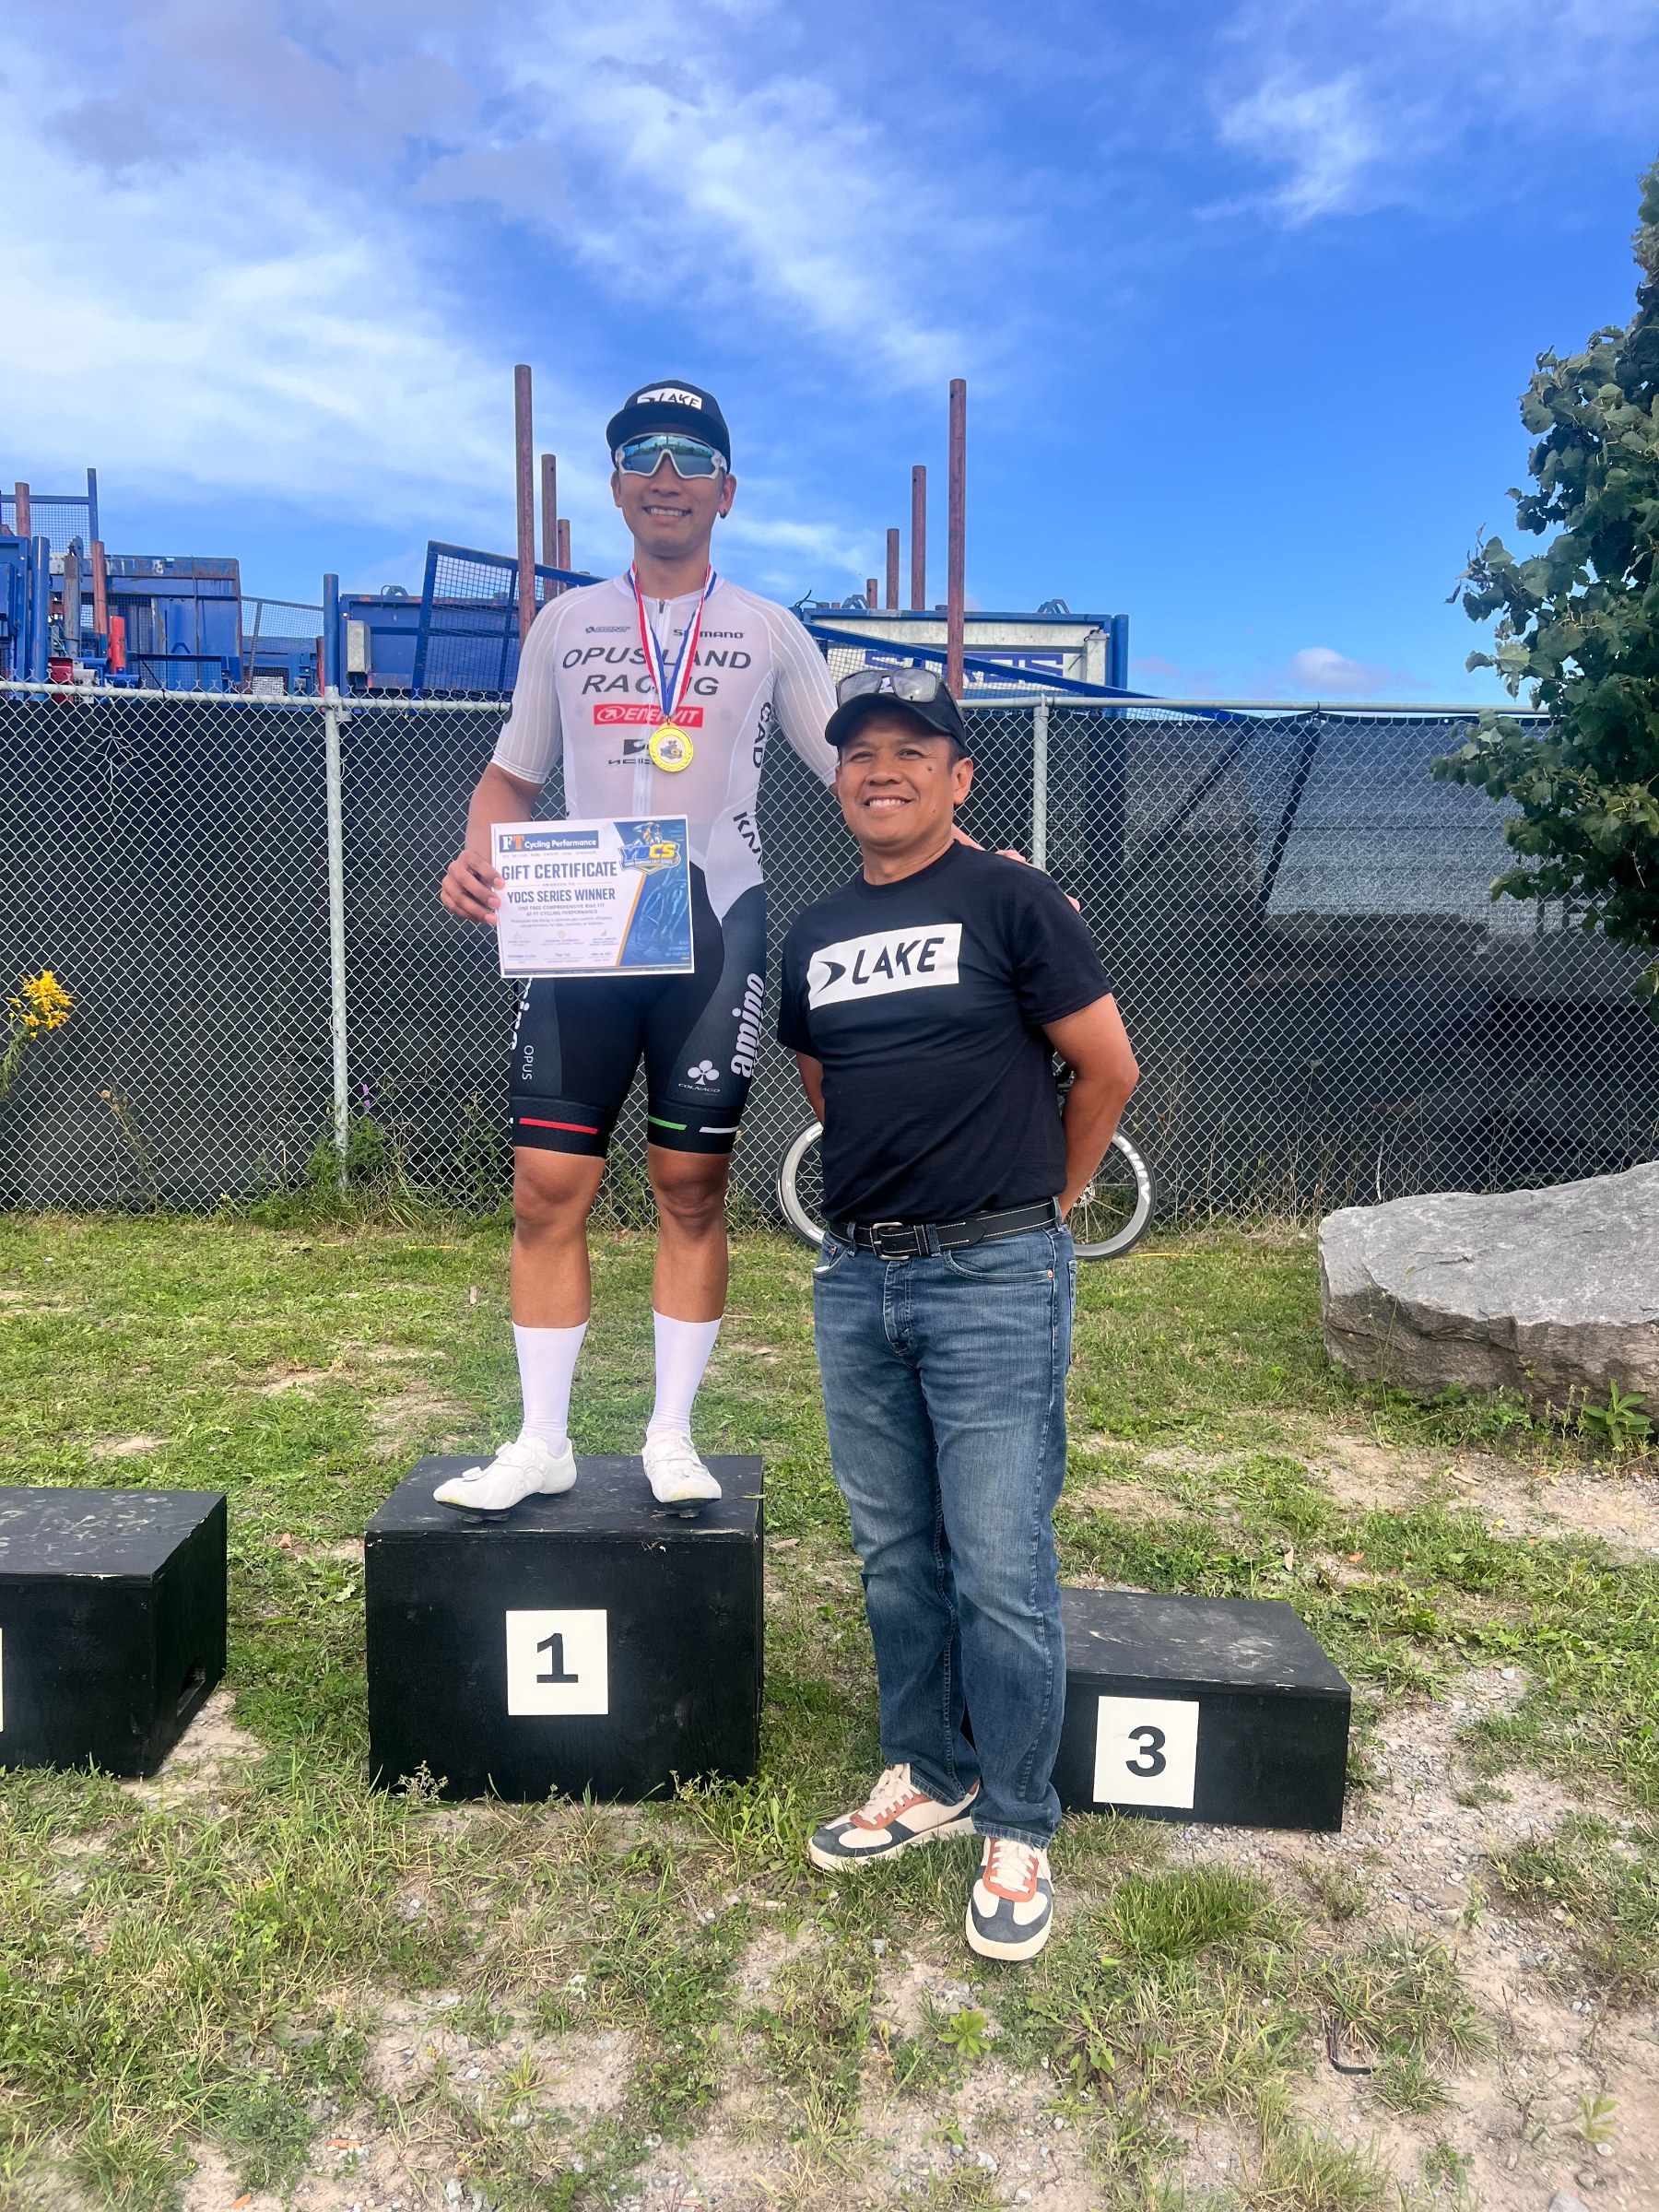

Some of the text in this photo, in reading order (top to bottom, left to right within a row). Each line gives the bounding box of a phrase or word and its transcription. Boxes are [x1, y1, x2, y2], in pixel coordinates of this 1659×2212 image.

[673, 629, 744, 639] SMANO
[562, 646, 646, 669] OPUS
[582, 674, 719, 696] RACG
[624, 707, 700, 724] ENEIT
[501, 834, 596, 851] FT Cycling Performance
[501, 861, 618, 880] GIFT CERTIFICATE
[508, 888, 616, 903] YDCS SERIES WINNER
[852, 936, 946, 985] LAKE
[731, 972, 764, 1078] amino
[522, 1044, 535, 1080] OPUS
[535, 1631, 579, 1684] 1
[1125, 1724, 1167, 1778] 3
